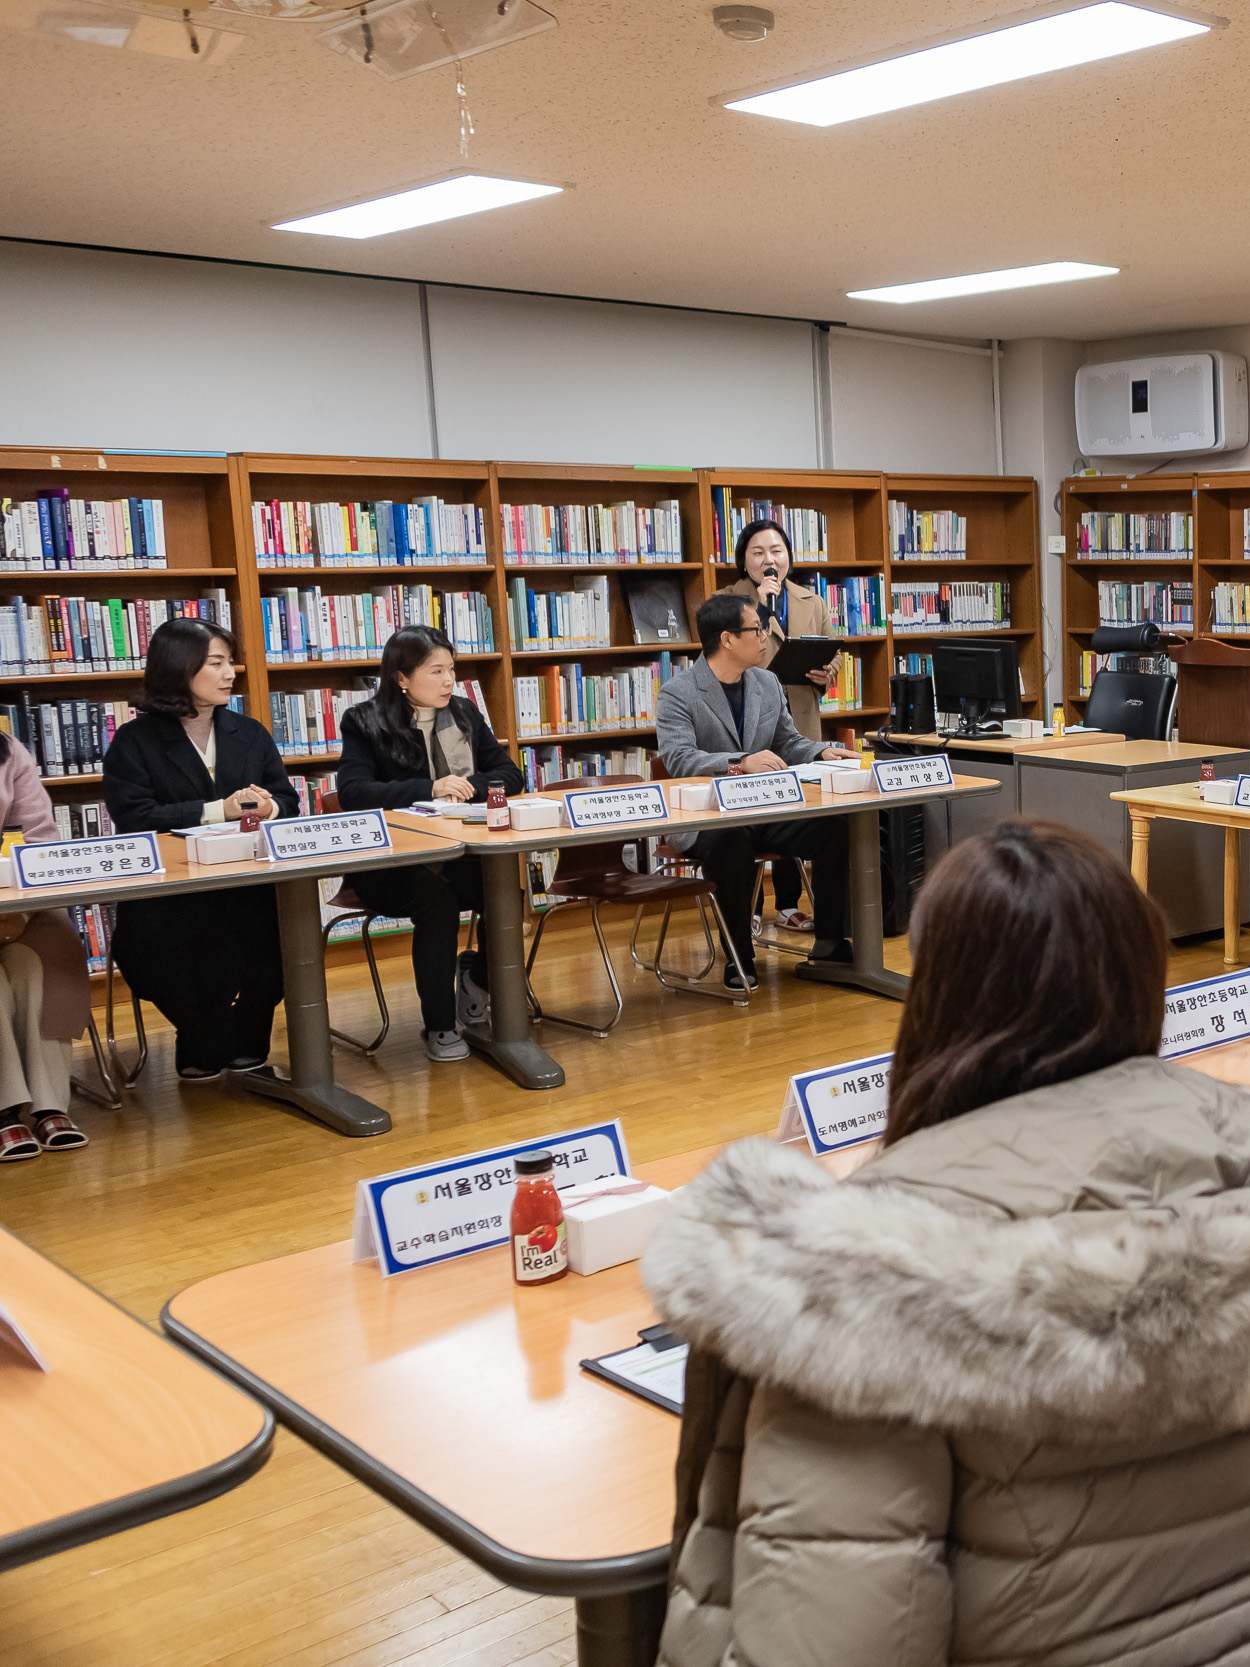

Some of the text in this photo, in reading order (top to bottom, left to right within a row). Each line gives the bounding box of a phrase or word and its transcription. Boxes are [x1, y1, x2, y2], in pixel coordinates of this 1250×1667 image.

[891, 761, 938, 773] 서울장안초등학교
[735, 777, 788, 789] 서울장안초등학교
[885, 777, 903, 786] 교감
[589, 792, 650, 804] 서울장안초등학교
[576, 810, 622, 821] 교육과정부장
[294, 818, 368, 834] 서울장안초등학교
[48, 842, 136, 859] 서울장안초등학교
[276, 841, 317, 854] 행정실장
[27, 866, 92, 879] 학교운영위원장
[1165, 984, 1249, 1014] 서울장안초등학교
[1160, 1027, 1205, 1047] 모니터링회장
[818, 1109, 887, 1137] 도서명예교사회
[434, 1148, 589, 1200] 서울장안학교
[395, 1214, 503, 1253] 교수학습지원회장
[520, 1245, 540, 1257] I'm
[522, 1250, 558, 1271] Real
